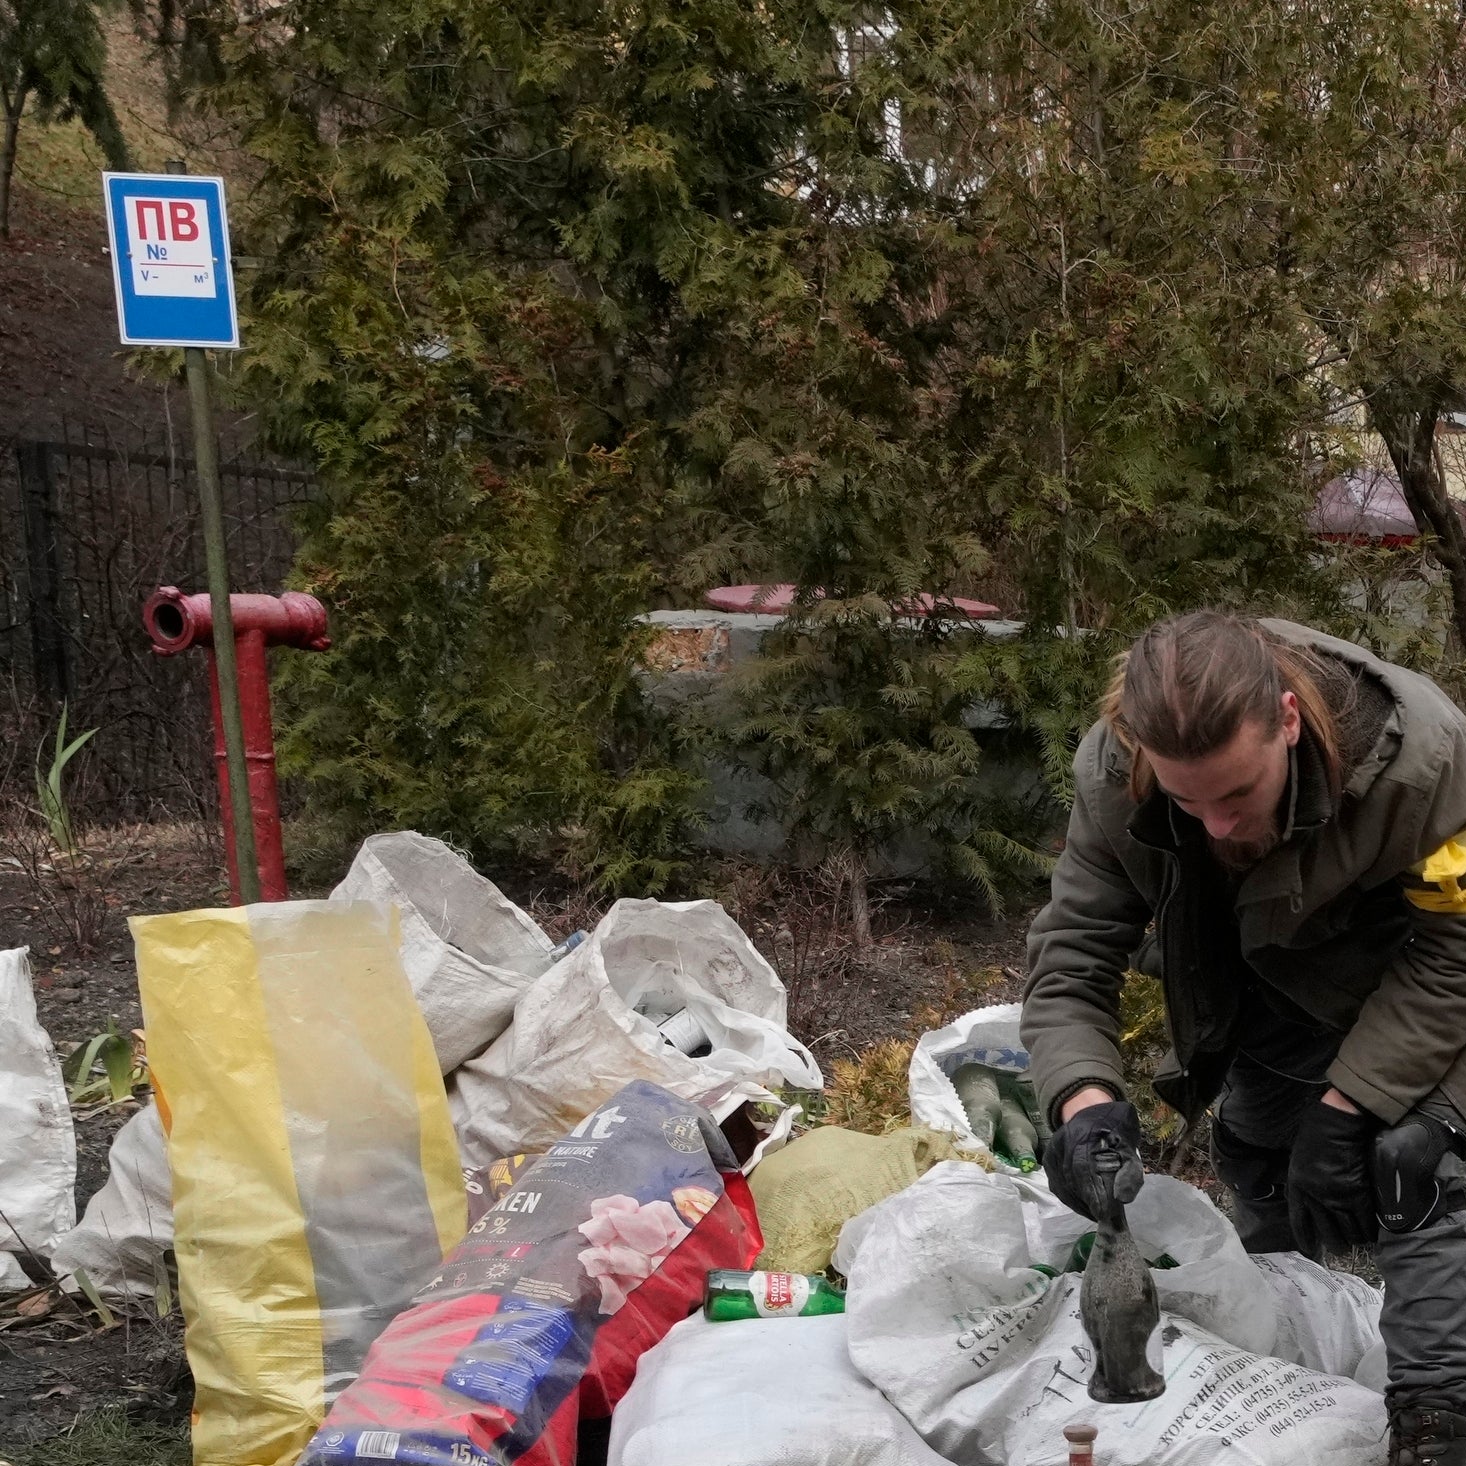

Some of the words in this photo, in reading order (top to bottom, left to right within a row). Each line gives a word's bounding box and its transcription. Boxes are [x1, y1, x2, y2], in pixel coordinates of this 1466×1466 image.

[135, 200, 200, 242] ПВ
[1240, 1383, 1279, 1412] (04735)
[1269, 1416, 1297, 1438] (044)
